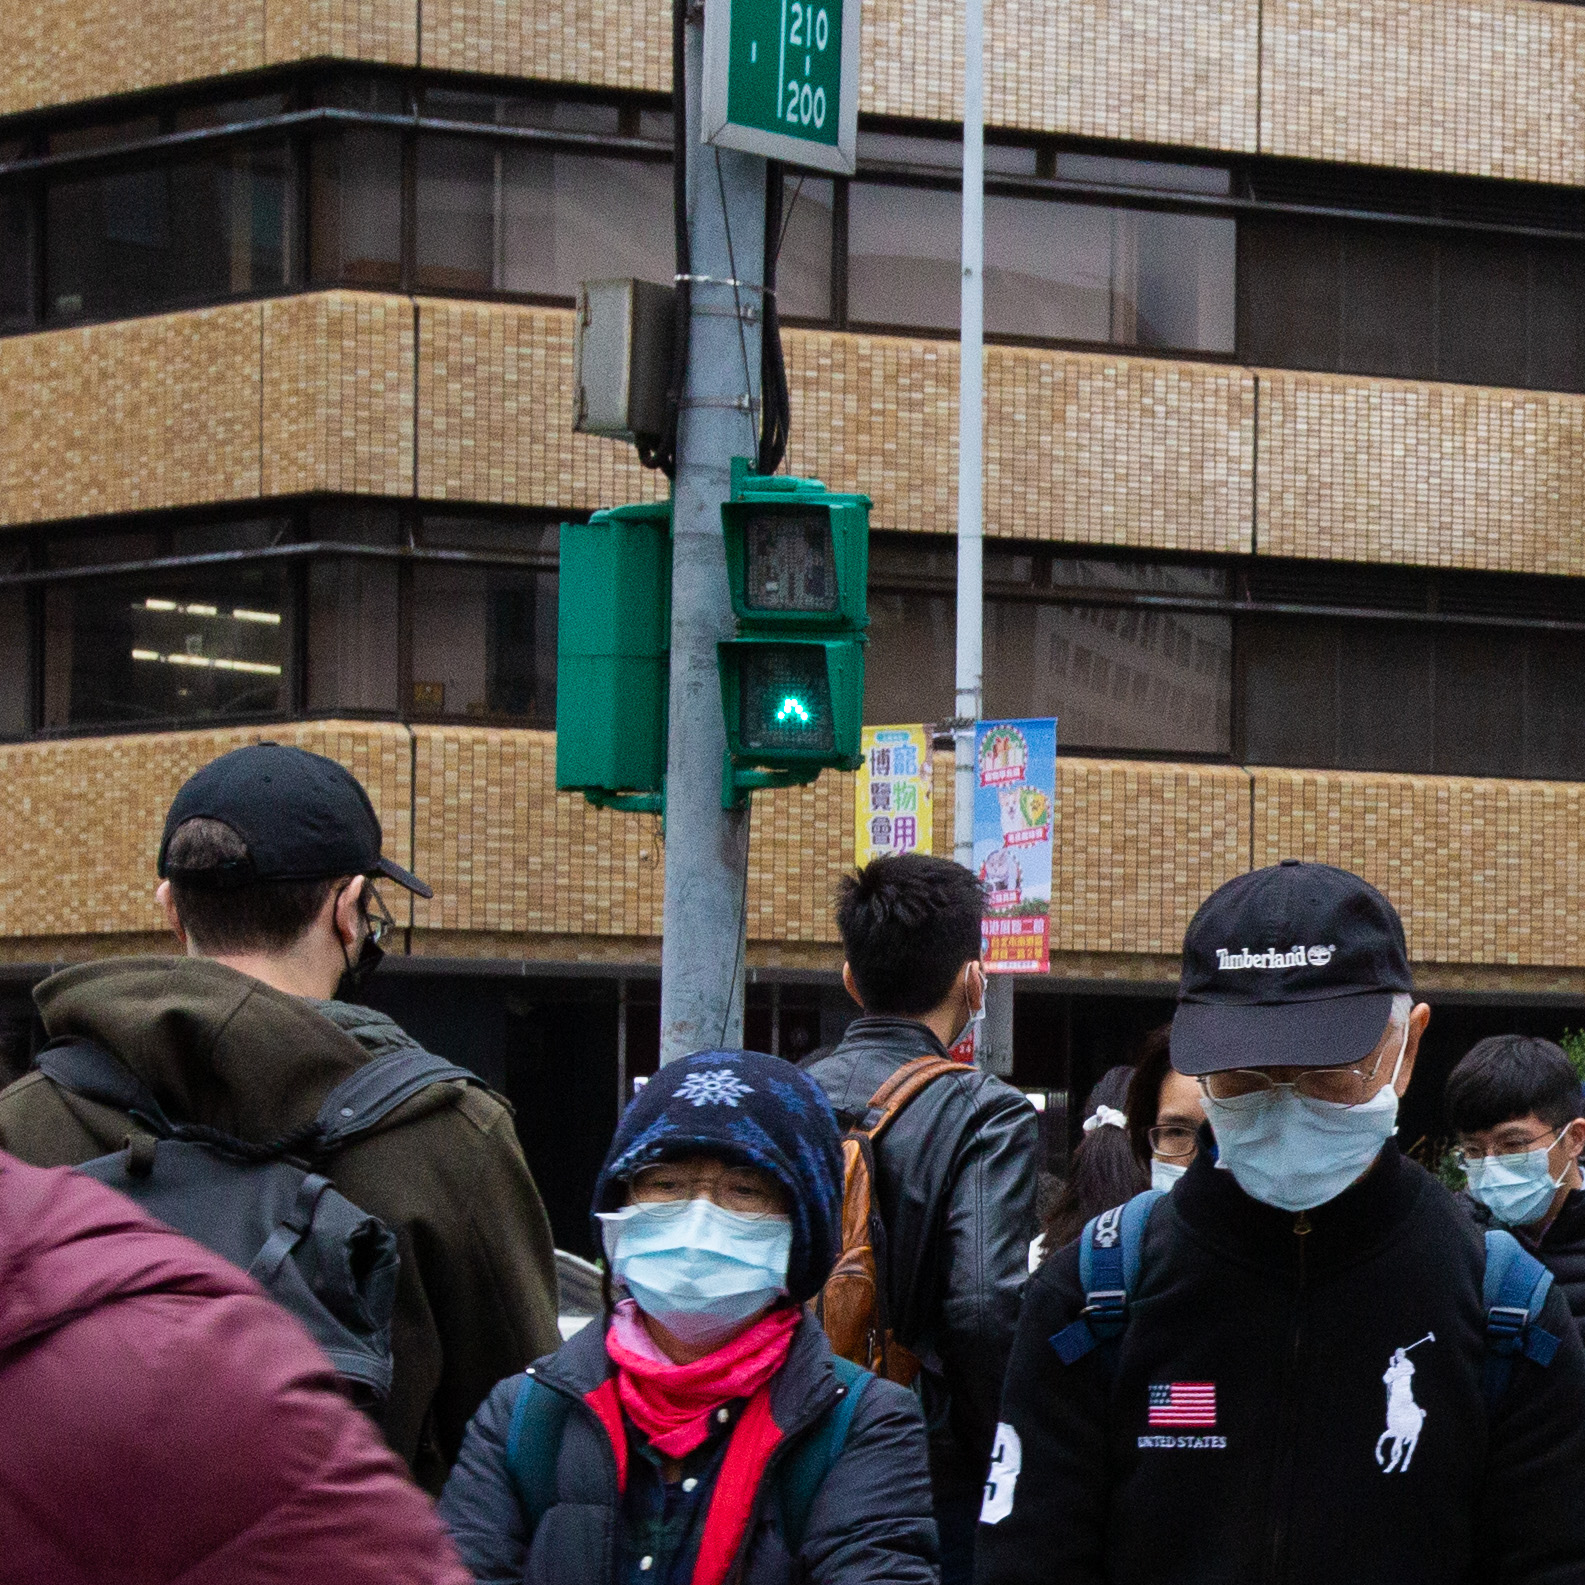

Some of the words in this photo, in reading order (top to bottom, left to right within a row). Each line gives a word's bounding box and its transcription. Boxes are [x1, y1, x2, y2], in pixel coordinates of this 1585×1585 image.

[790, 2, 828, 51] 210
[786, 80, 826, 129] 200
[1216, 945, 1307, 970] Timberland
[1137, 1436, 1176, 1449] UNITED
[1177, 1436, 1227, 1449] STATES
